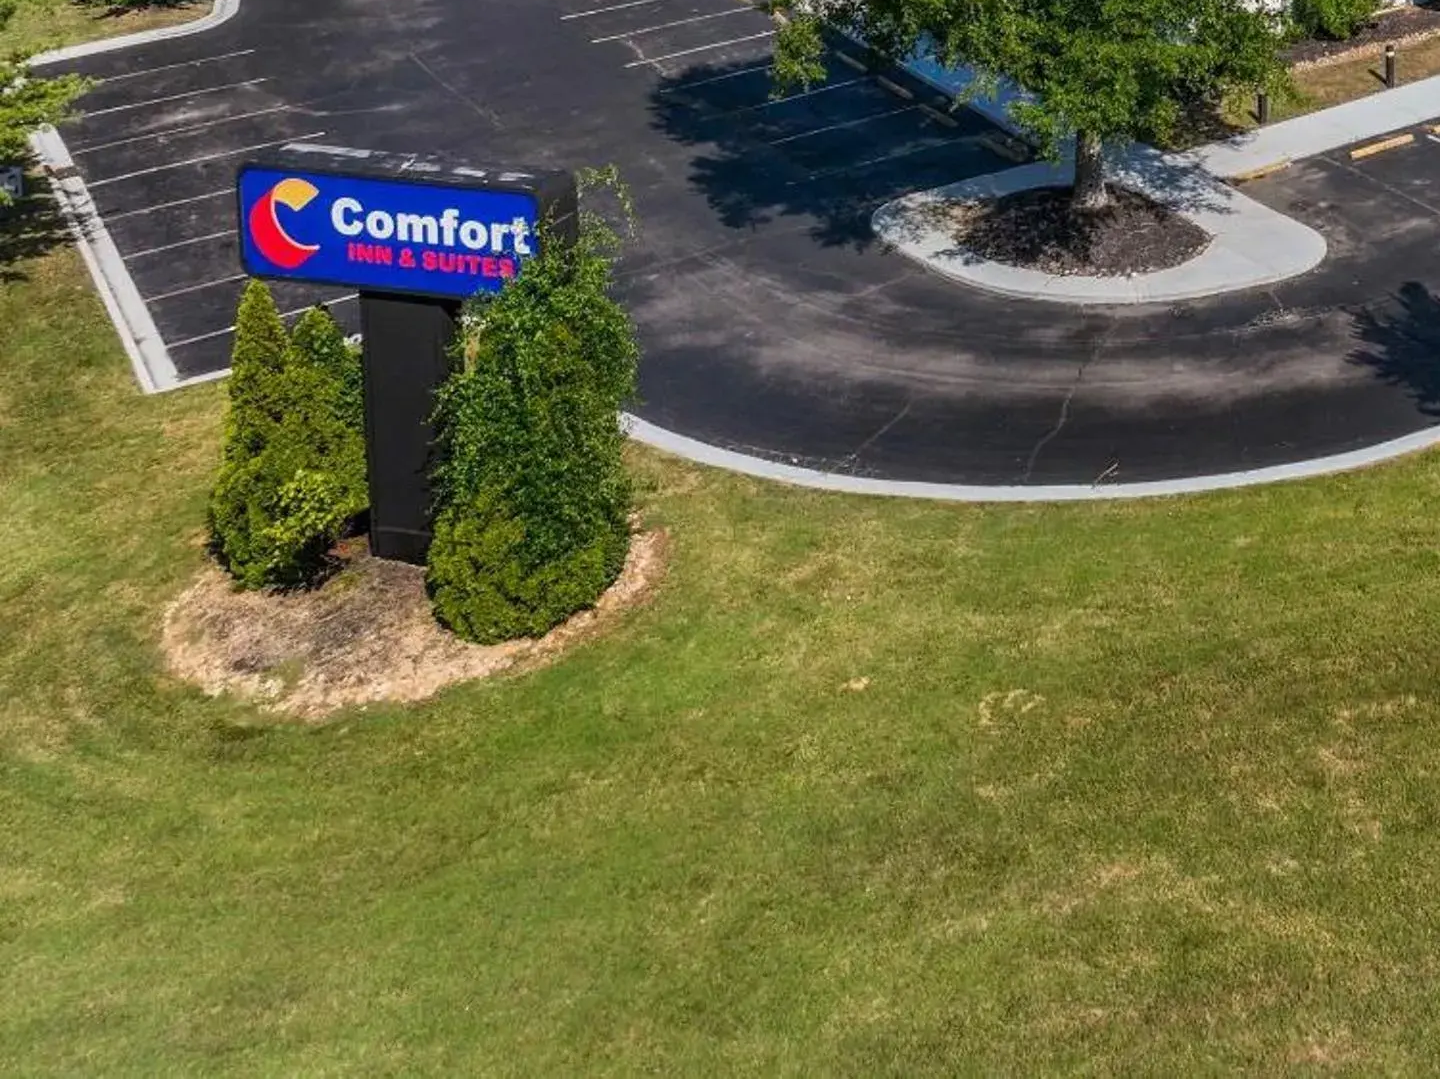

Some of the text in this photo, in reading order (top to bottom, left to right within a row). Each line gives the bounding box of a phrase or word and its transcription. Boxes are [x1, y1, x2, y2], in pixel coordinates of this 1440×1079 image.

[331, 197, 530, 254] Comfort
[347, 242, 515, 278] INN & SUITES
